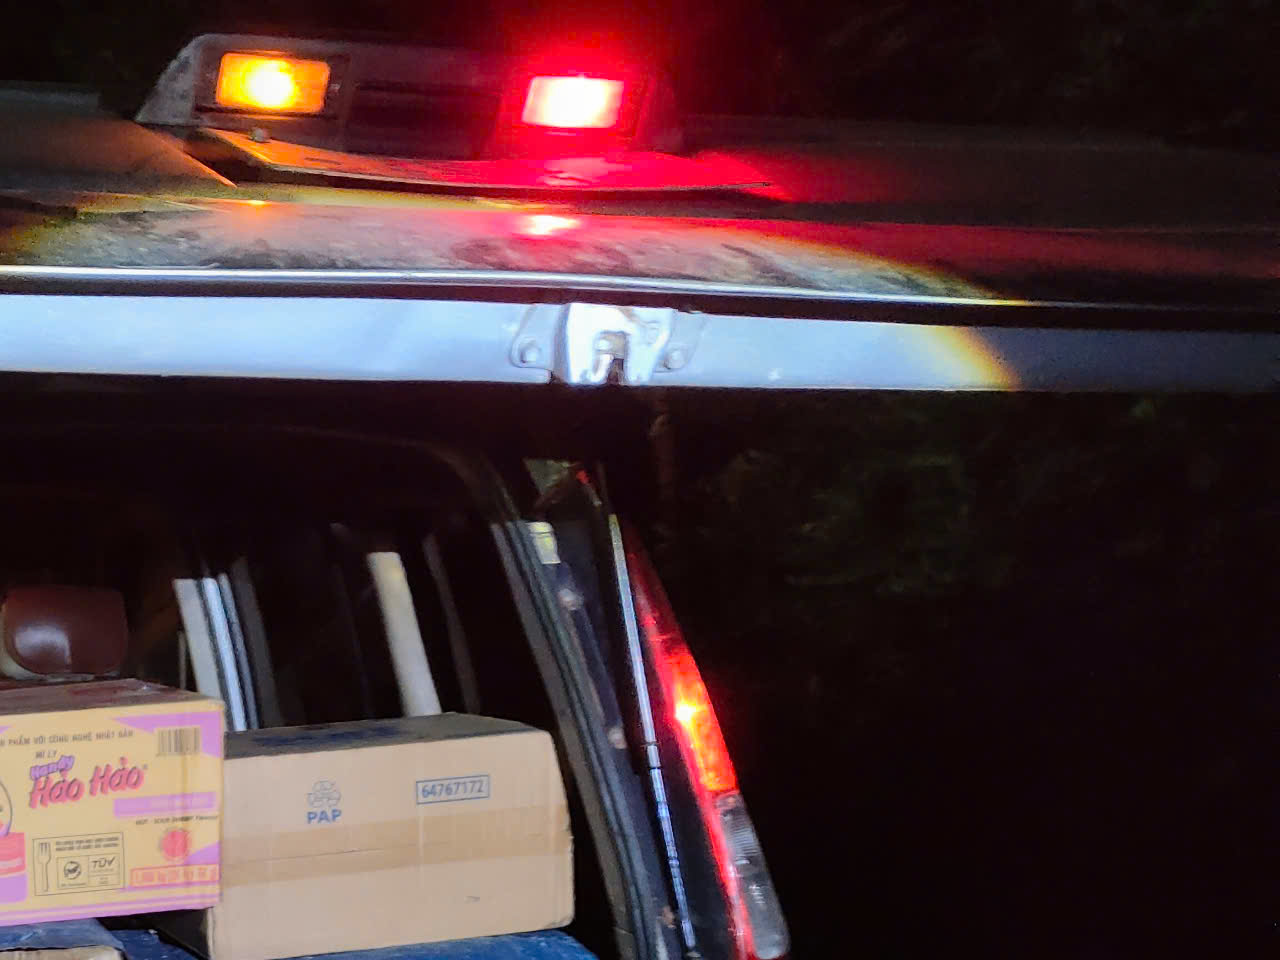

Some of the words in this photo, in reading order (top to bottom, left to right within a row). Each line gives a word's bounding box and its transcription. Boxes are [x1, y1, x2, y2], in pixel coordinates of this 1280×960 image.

[29, 768, 85, 808] Hảo
[89, 756, 145, 797] Hảo
[422, 779, 483, 798] 64767172
[307, 808, 342, 824] PAP
